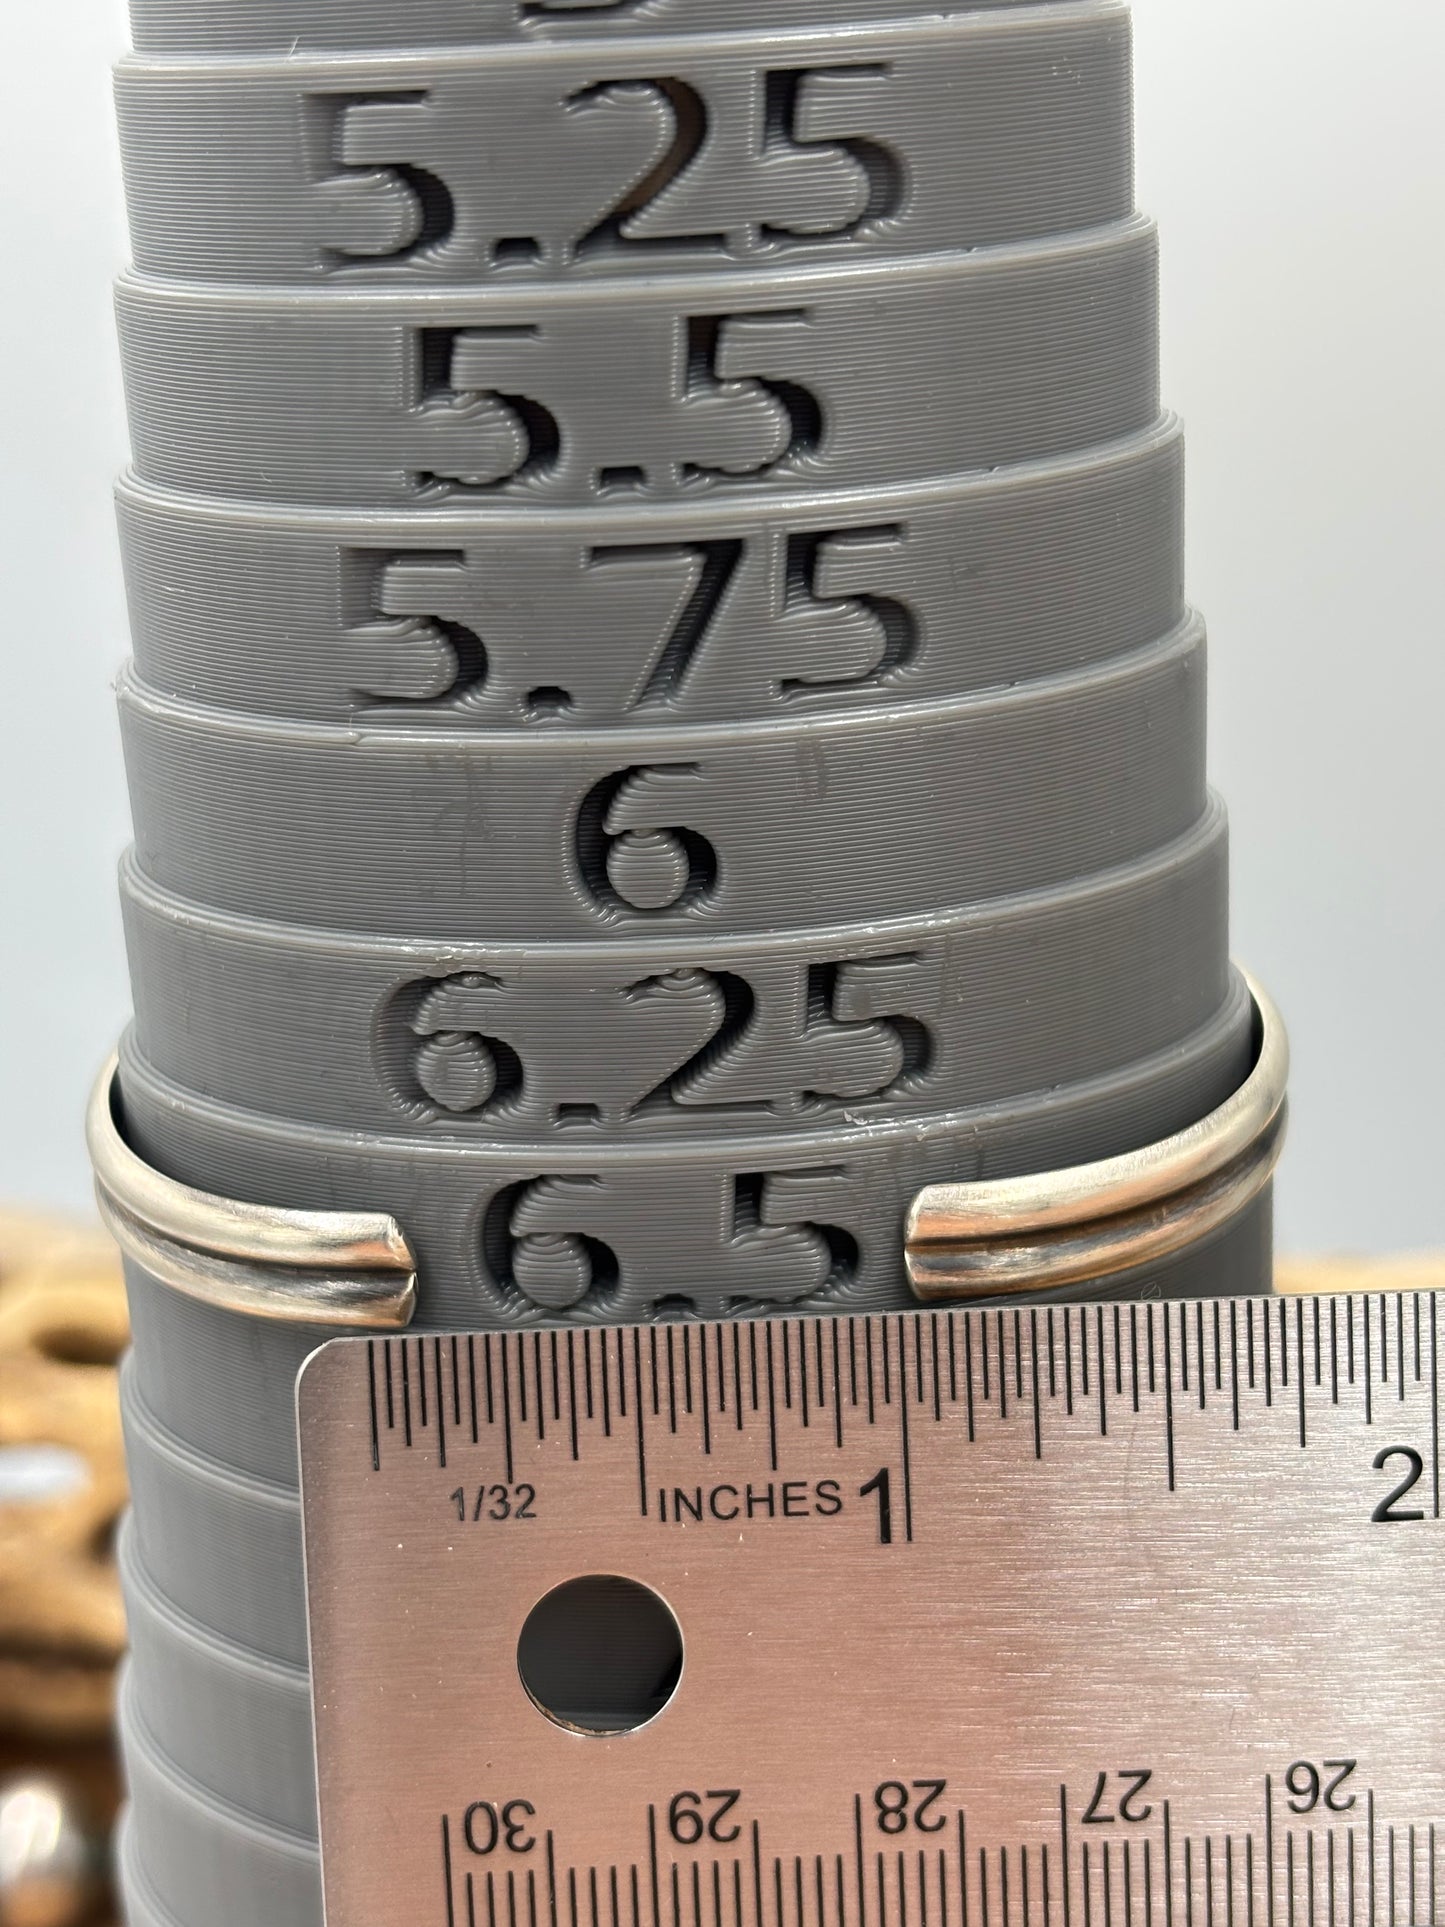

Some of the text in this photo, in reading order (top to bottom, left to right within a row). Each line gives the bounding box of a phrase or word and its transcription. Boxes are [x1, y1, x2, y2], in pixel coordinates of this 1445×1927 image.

[298, 62, 914, 274] 5.25
[402, 309, 824, 496] 5.5
[337, 523, 922, 716] 5.75
[566, 761, 722, 927] 6
[374, 952, 937, 1128] 6.25
[472, 1164, 863, 1322] 6.5
[449, 1483, 538, 1522] 1/32
[659, 1479, 844, 1523] INCHES
[859, 1467, 893, 1544] 1
[1371, 1445, 1426, 1523] 2
[669, 1788, 742, 1845] 29
[874, 1779, 947, 1834] 28
[1081, 1768, 1153, 1824] 27
[1285, 1758, 1358, 1814] 26
[464, 1799, 536, 1855] 30
